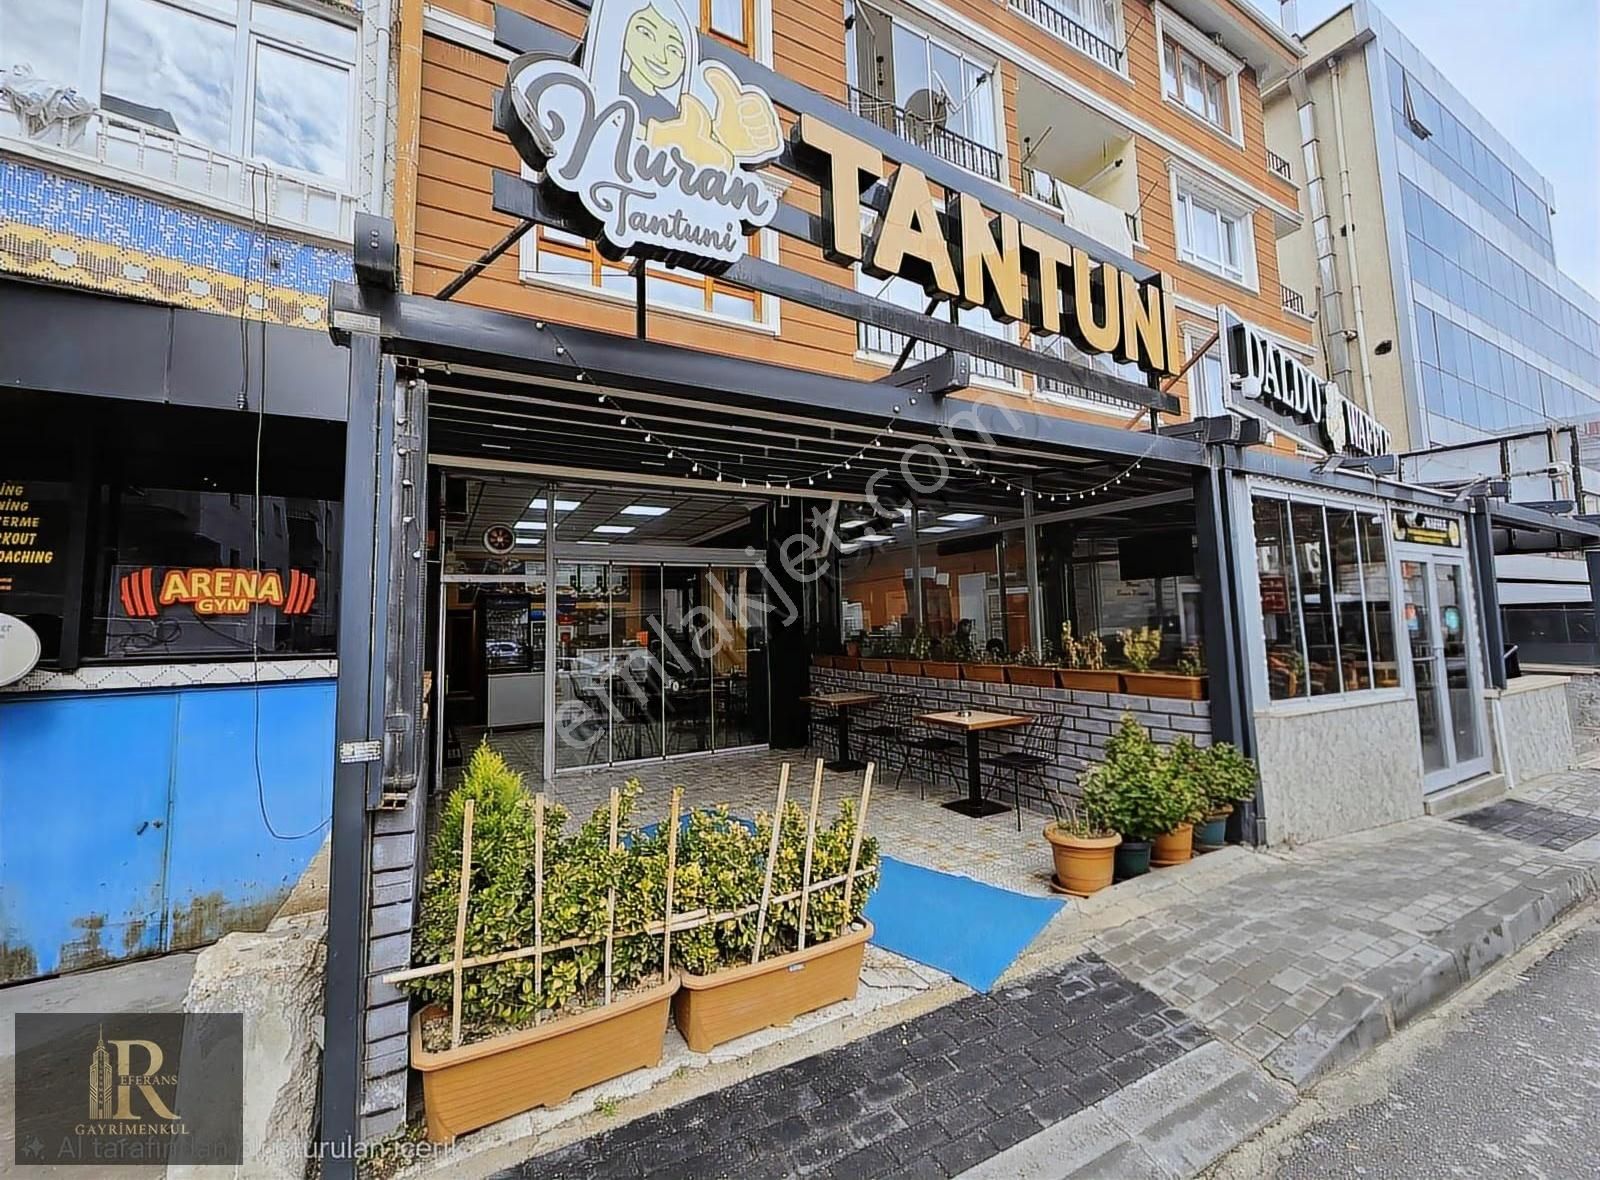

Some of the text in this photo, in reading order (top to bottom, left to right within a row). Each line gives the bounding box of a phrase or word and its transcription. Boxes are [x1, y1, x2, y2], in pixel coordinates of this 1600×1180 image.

[524, 72, 769, 217] Nuran
[589, 180, 738, 252] Tantuni
[799, 111, 1181, 377] TANTUNI
[0, 532, 37, 545] KOUT
[162, 571, 281, 602] ARENA
[198, 598, 249, 613] GYM
